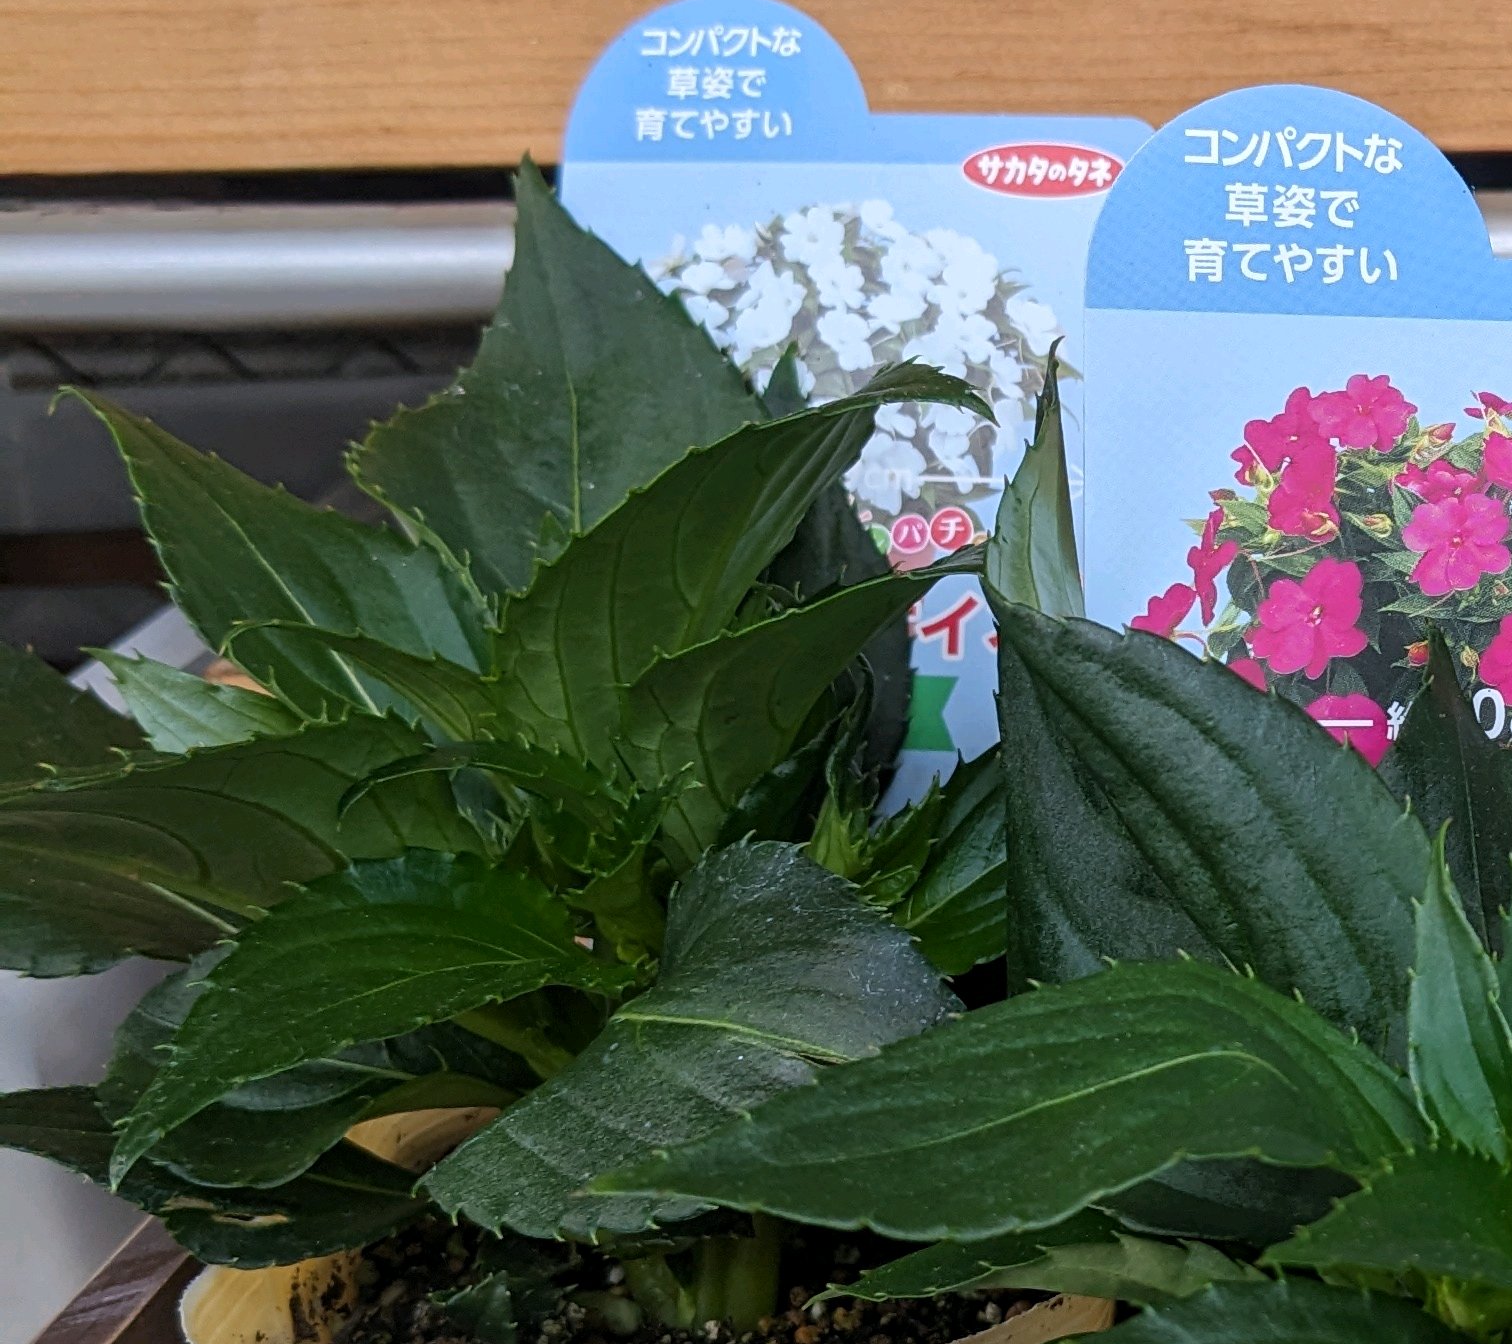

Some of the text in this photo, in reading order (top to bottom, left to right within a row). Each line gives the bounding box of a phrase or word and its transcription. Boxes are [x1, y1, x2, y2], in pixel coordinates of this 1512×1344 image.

[640, 24, 803, 58] コンパクトな
[666, 66, 767, 100] 草姿で
[635, 108, 793, 141] 育てやすい
[1184, 125, 1404, 175] コンパクトな
[977, 155, 1113, 187] サカタのタネ
[1224, 182, 1361, 229] 草姿で
[1183, 237, 1399, 285] 育てやすい
